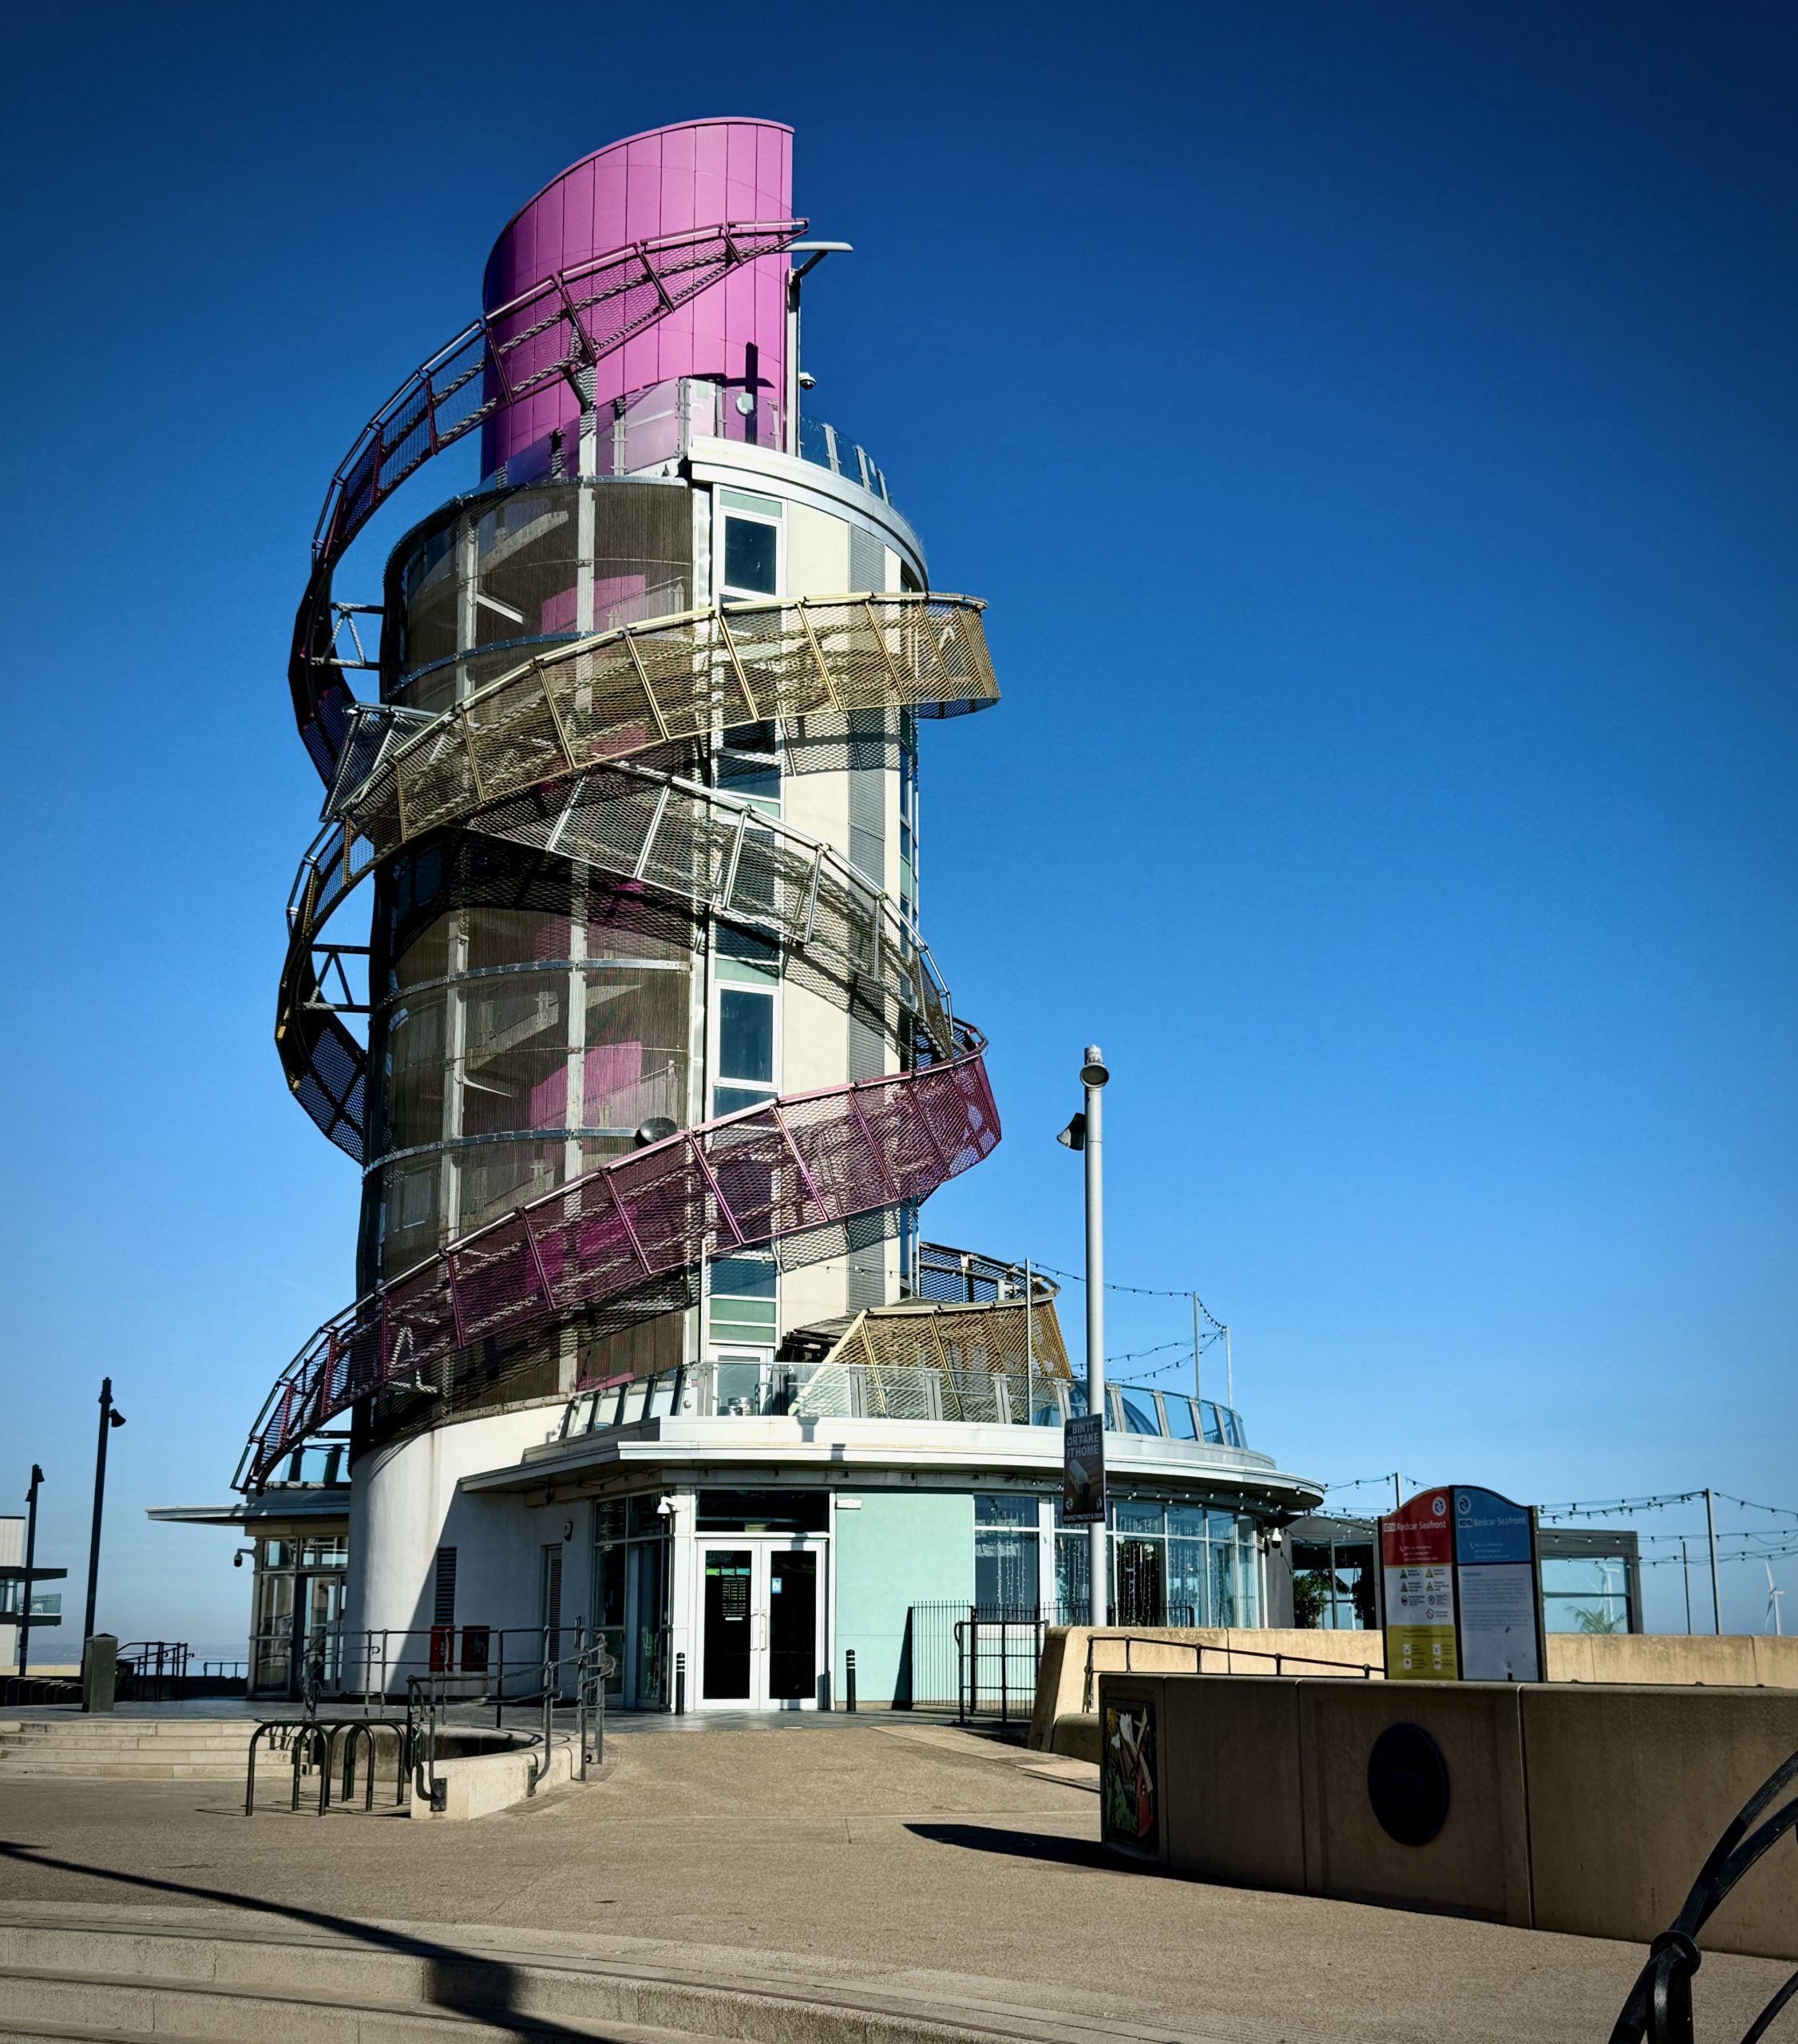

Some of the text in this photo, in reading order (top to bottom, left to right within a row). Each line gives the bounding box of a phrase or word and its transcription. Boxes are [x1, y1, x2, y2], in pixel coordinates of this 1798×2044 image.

[1072, 1421, 1094, 1434] BIN IT
[1067, 1432, 1099, 1447] OR TAKE
[1067, 1444, 1099, 1458] IT HOME
[1396, 1522, 1417, 1531] Redcar
[1419, 1519, 1447, 1530] Seafront
[1473, 1518, 1495, 1527] Redcar
[1497, 1516, 1527, 1526] Seafront
